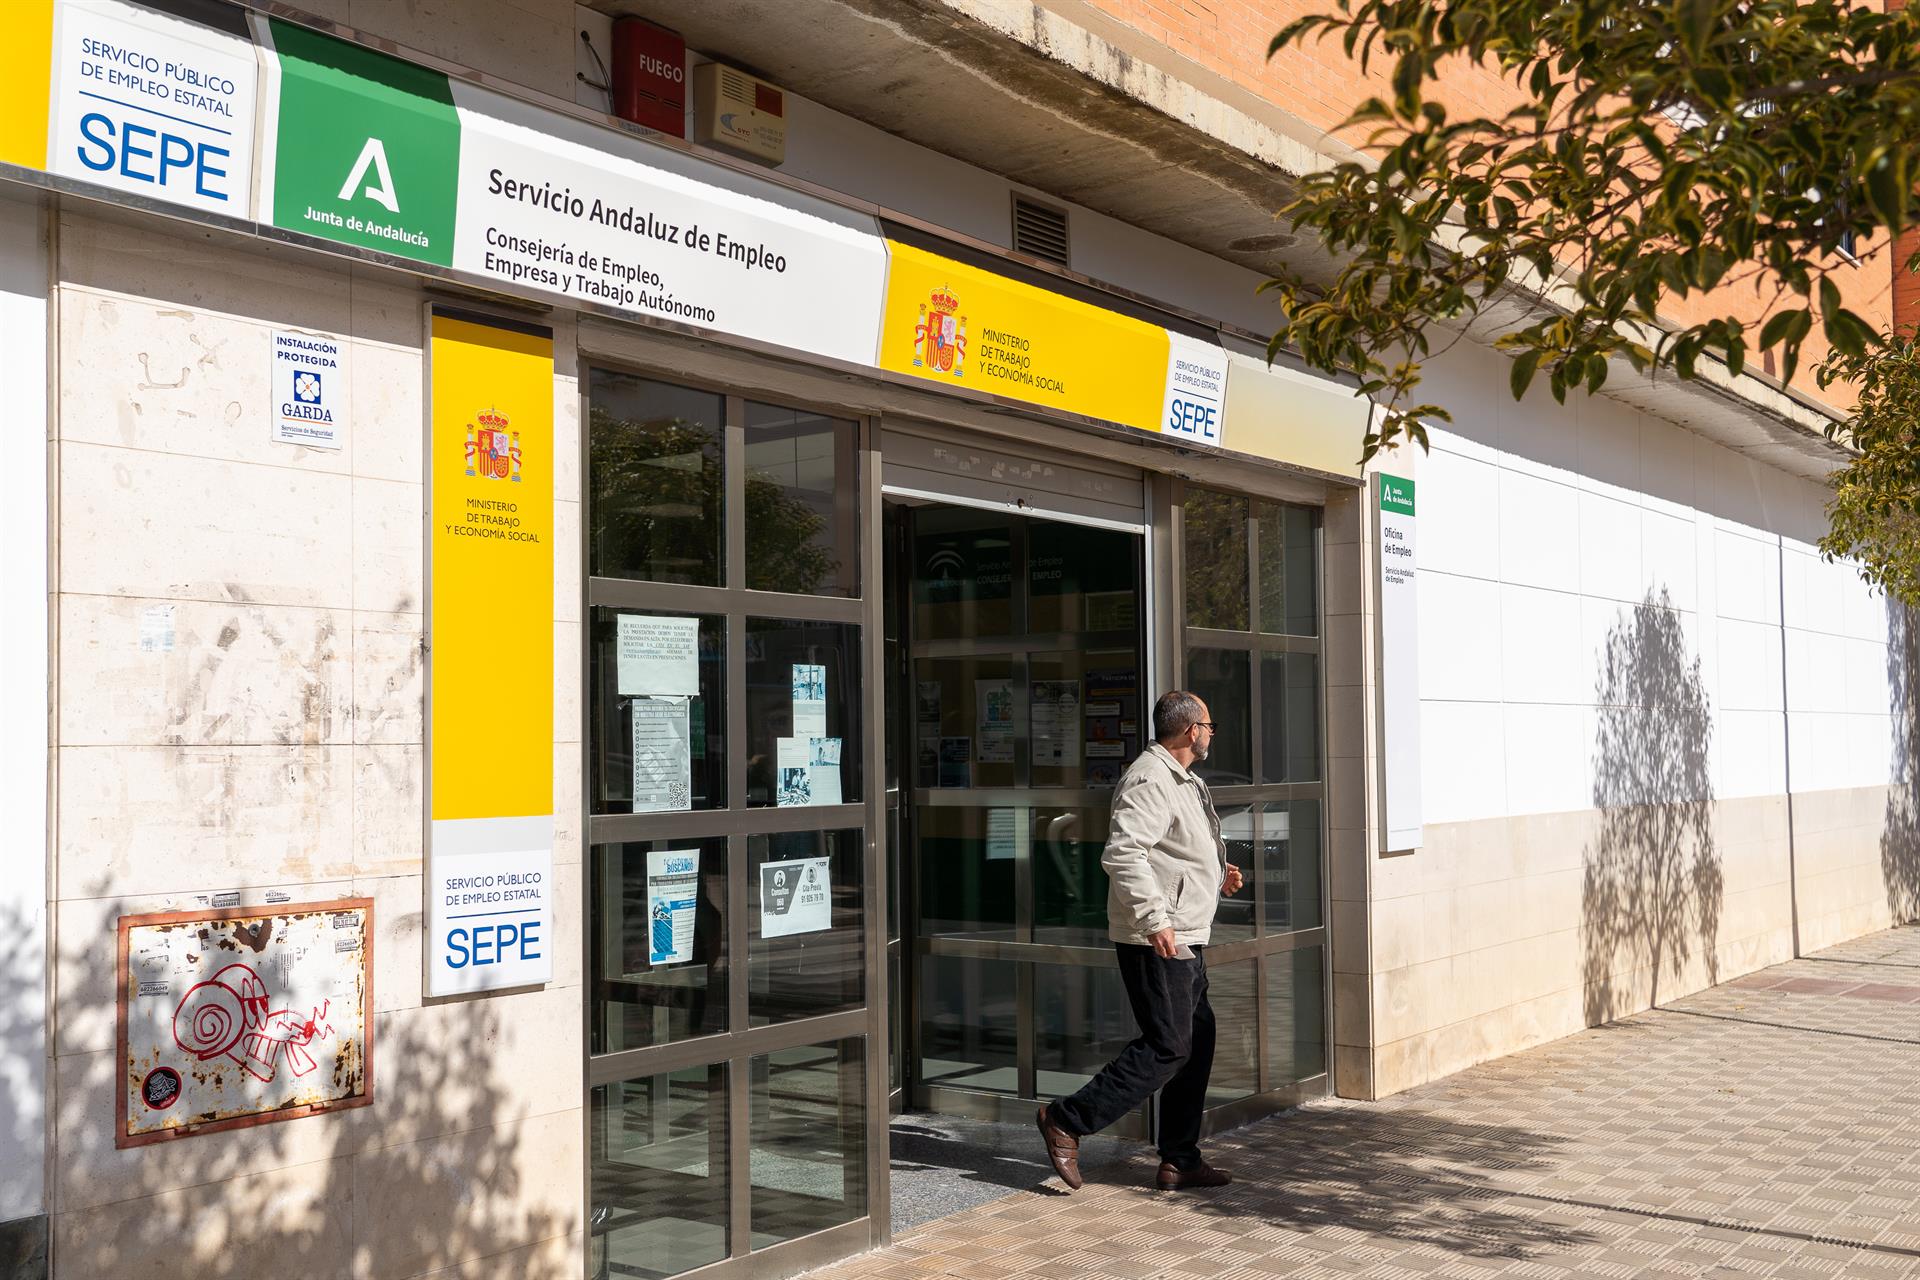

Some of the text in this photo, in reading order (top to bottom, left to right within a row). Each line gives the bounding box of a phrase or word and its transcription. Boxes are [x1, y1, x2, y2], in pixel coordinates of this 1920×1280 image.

[81, 37, 235, 96] SERVICIO PÚBLICO
[638, 53, 683, 83] FUEGO
[80, 61, 233, 118] DE EMPLEO ESTATAL
[77, 112, 230, 201] SEPE
[304, 205, 430, 249] Junta de Andalucía
[487, 168, 787, 274] Servicio Andaluz de Empleo
[486, 226, 665, 292] Consejería de Empleo,
[484, 252, 716, 323] Empresa y Trabajo Autónomo
[276, 336, 337, 354] INSTALACIÓN
[981, 327, 1031, 352] MINISTERIO
[277, 351, 337, 368] PROTEGIDA
[980, 345, 1031, 369] DE TRABAJO
[979, 362, 1065, 395] Y ECONOMÍA SOCIAL
[1175, 359, 1221, 381] SERVICIO PÚBLICO
[1174, 372, 1219, 393] DE EMPLEO ESTATAL
[282, 403, 333, 421] GARDA
[1170, 399, 1216, 438] SEPE
[281, 424, 333, 437] Servicios de Seguridad
[1392, 487, 1402, 496] Junta
[466, 498, 517, 512] MINISTERIO
[466, 512, 521, 530] DE TRABAJO
[445, 524, 540, 543] Y ECONOMÍA SOCIAL
[1384, 527, 1403, 541] Oficina
[1384, 542, 1412, 558] de Empleo
[1032, 569, 1062, 581] EMPLEO
[1385, 566, 1415, 578] Servicio Andaluz
[1390, 576, 1405, 585] Empleo
[445, 870, 542, 891] SERVICIO PÚBLICO
[445, 888, 542, 907] DE EMPLEO ESTATAL
[445, 920, 542, 970] SEPE
